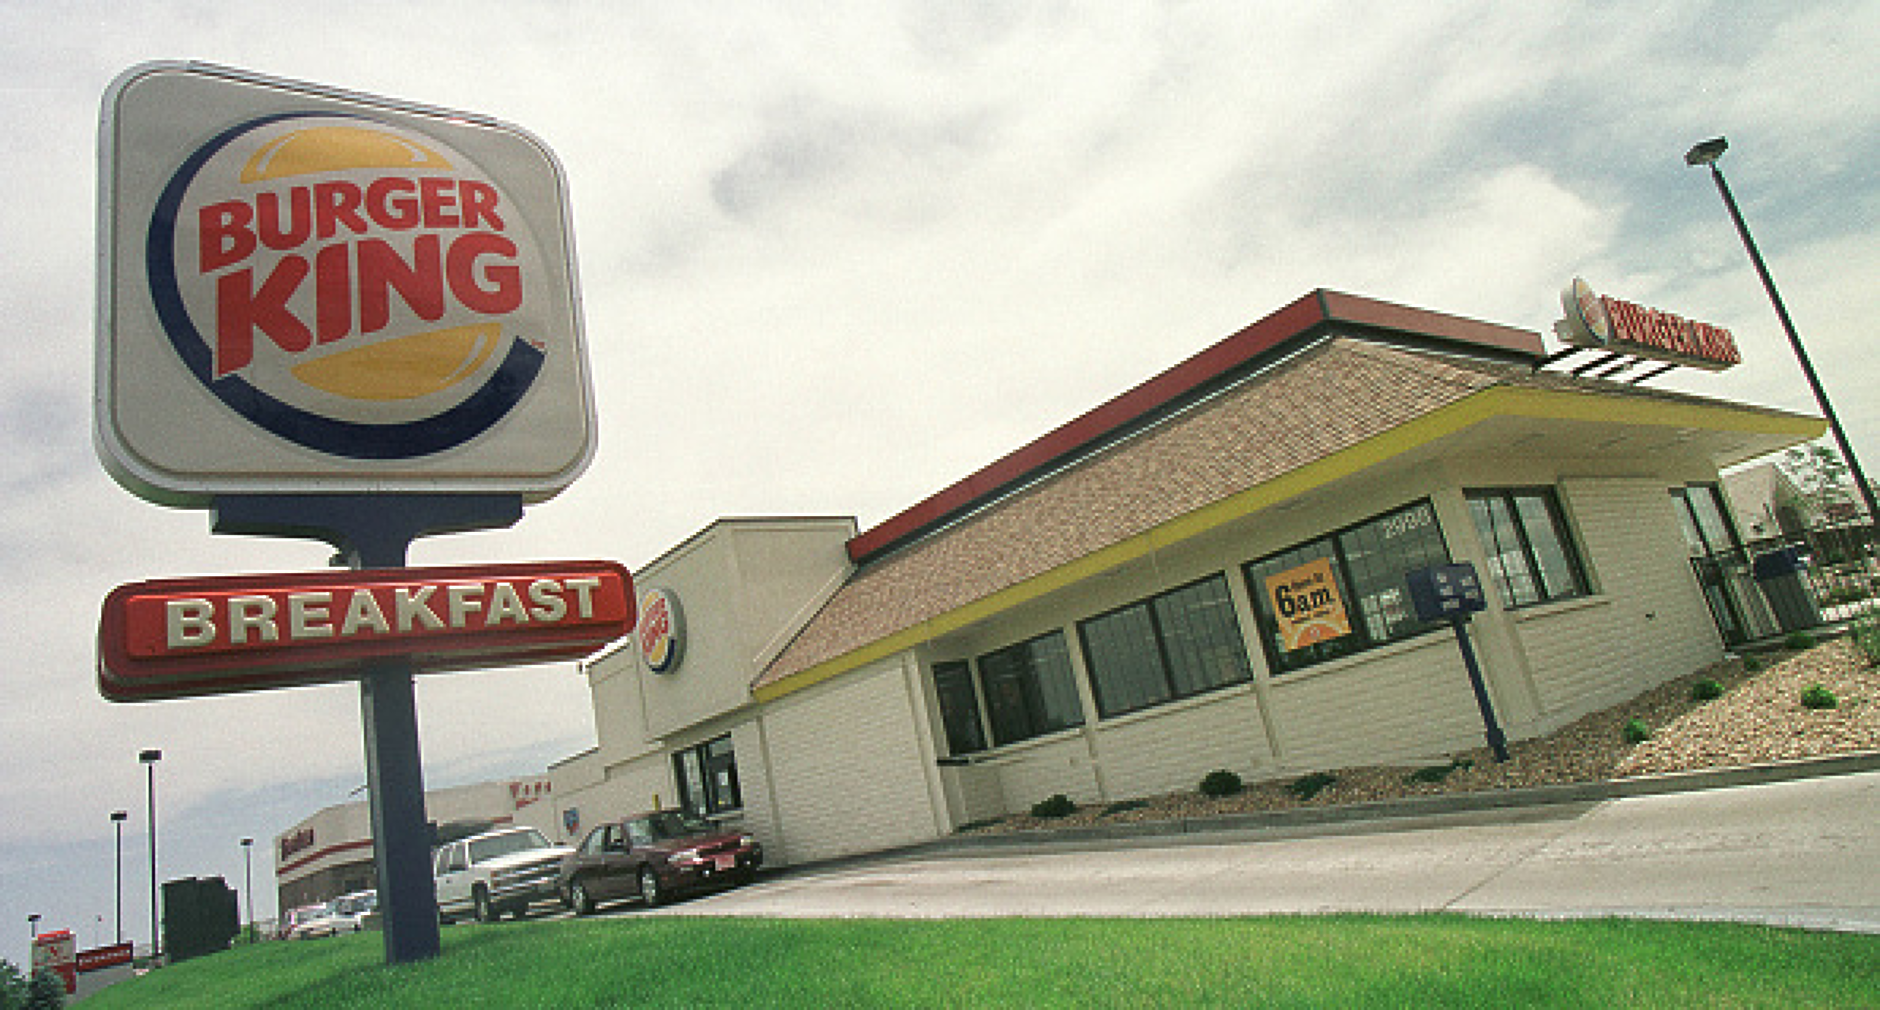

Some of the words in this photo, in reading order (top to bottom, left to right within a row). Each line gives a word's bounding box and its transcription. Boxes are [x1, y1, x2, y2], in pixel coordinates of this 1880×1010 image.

[199, 176, 505, 274] BURGER
[216, 231, 523, 377] KING
[165, 577, 601, 649] BREAKFAST
